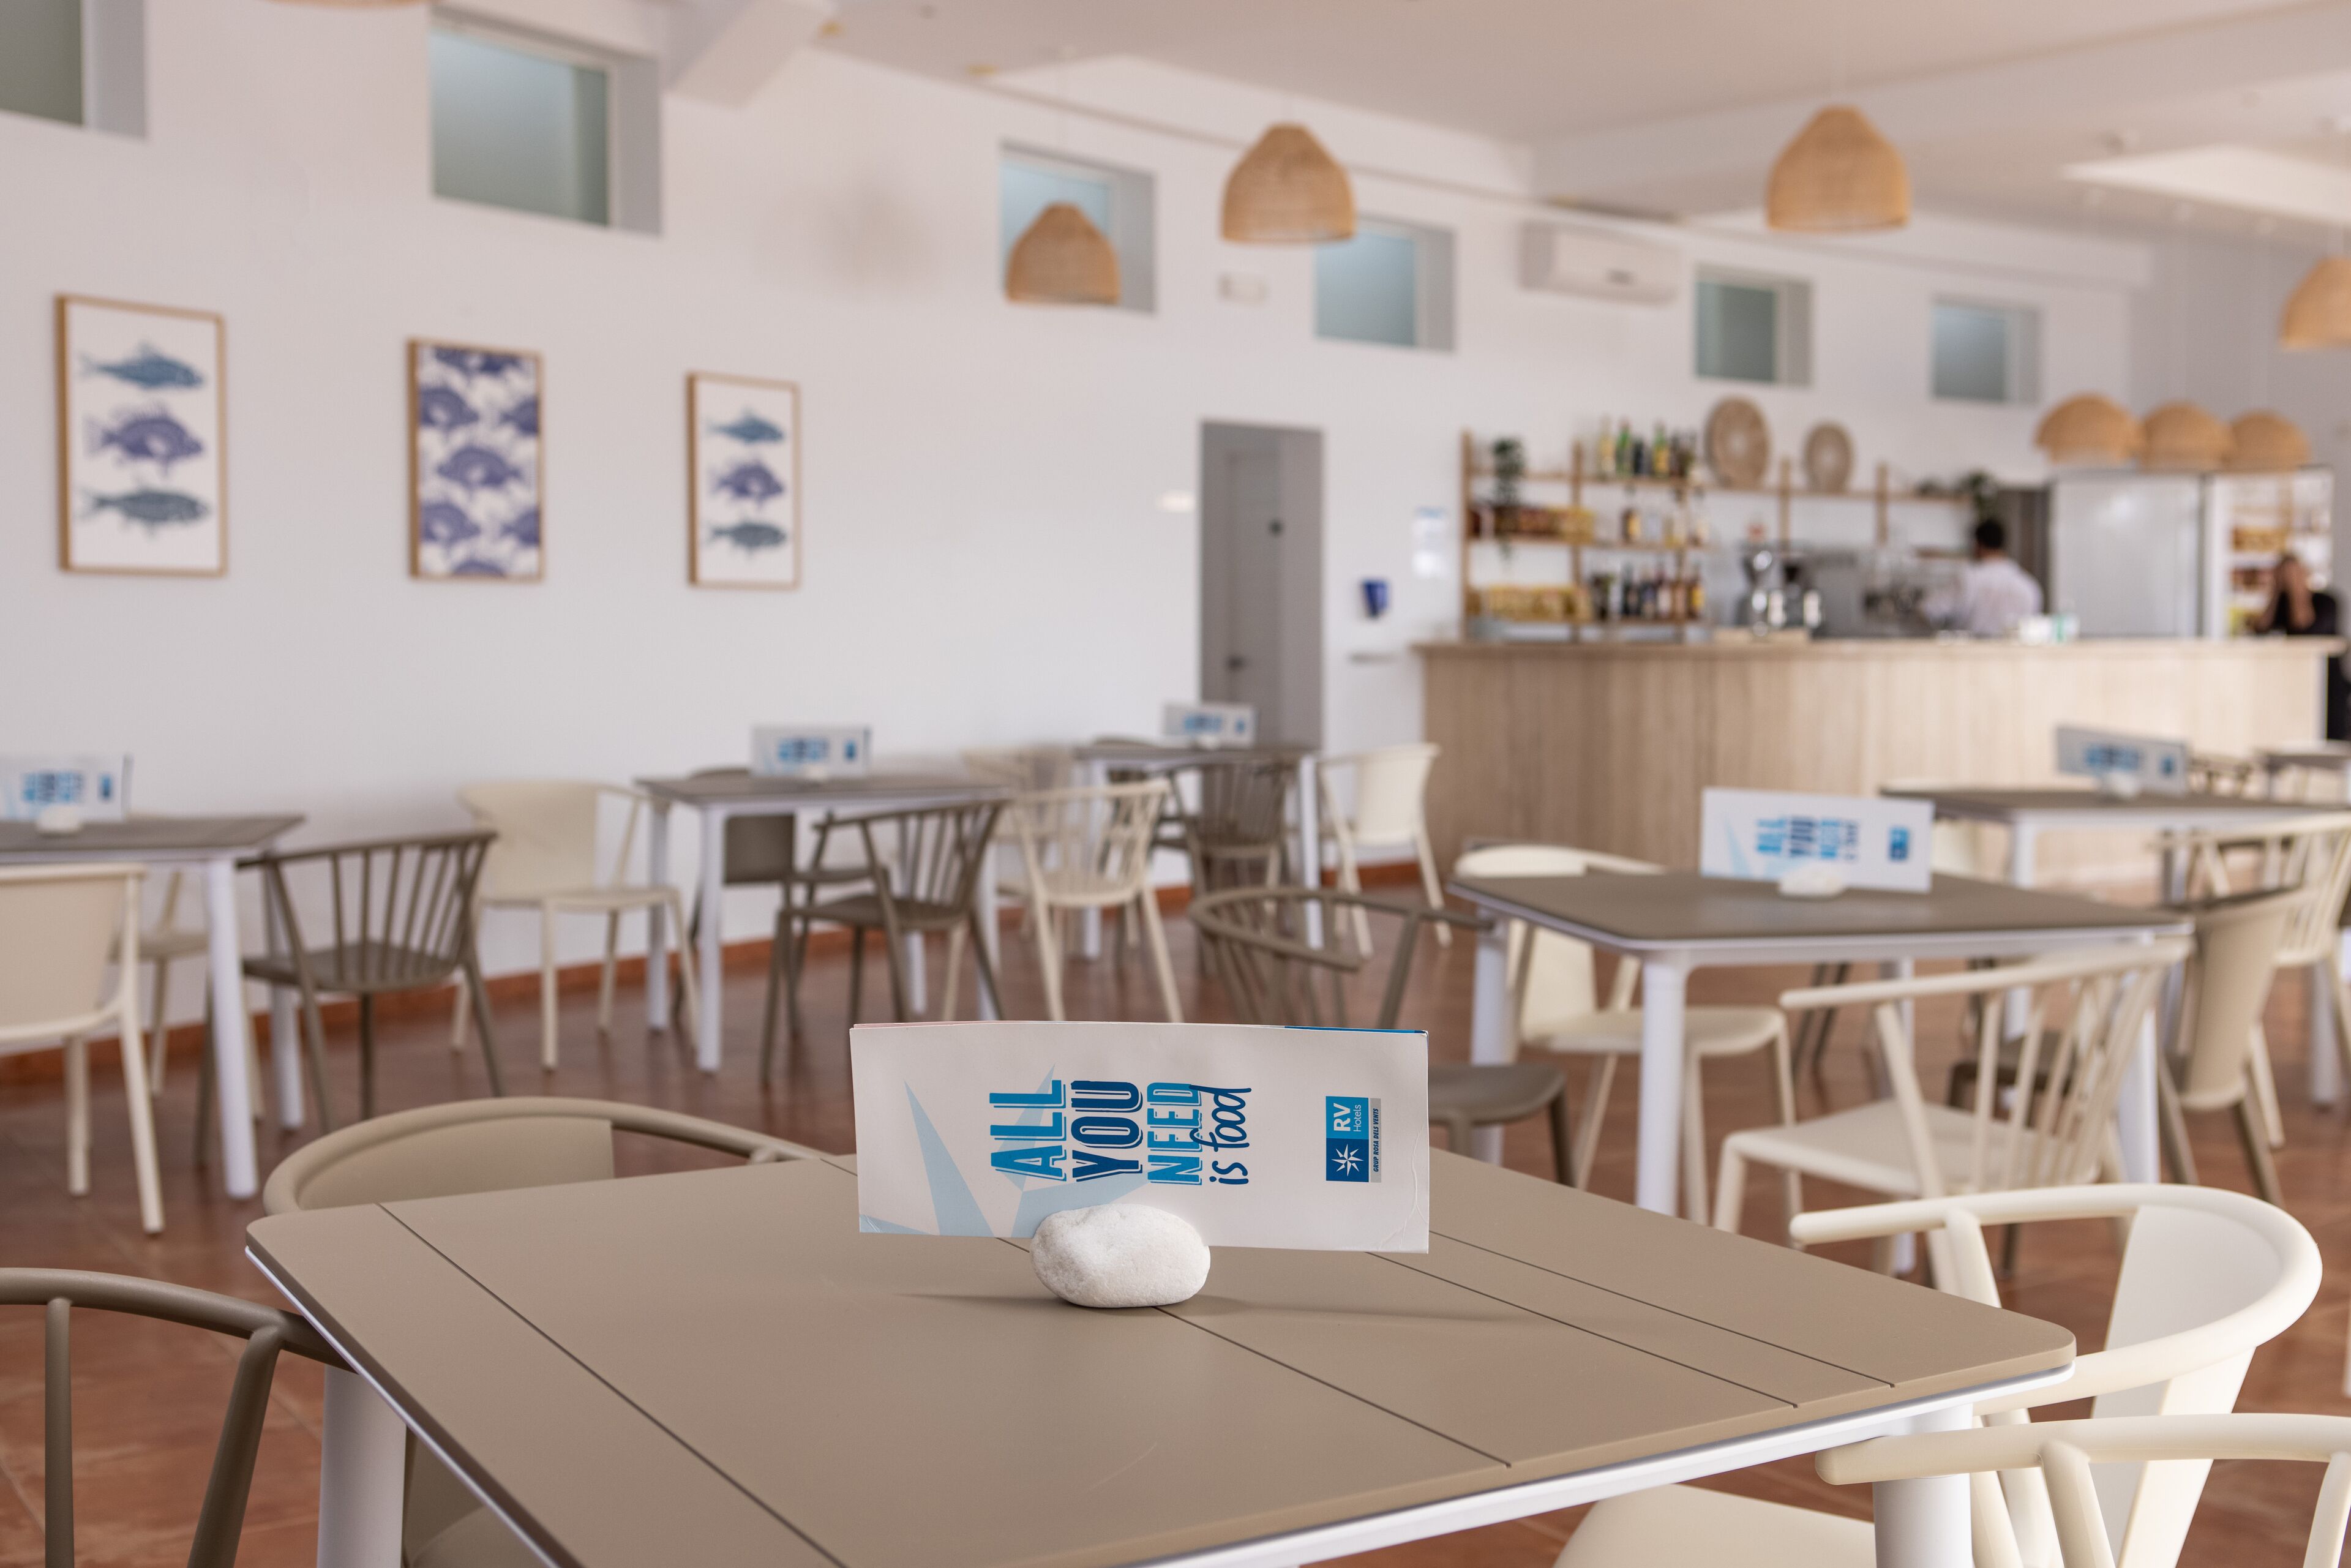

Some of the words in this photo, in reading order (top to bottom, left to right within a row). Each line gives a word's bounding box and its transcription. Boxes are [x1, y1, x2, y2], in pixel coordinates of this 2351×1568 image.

[989, 1080, 1066, 1181] ALL
[1071, 1080, 1143, 1182] YOU
[1147, 1082, 1202, 1185] NEED
[1189, 1084, 1251, 1152] food
[1333, 1103, 1351, 1131] RV
[1353, 1105, 1362, 1132] Hotels
[1209, 1160, 1249, 1185] is
